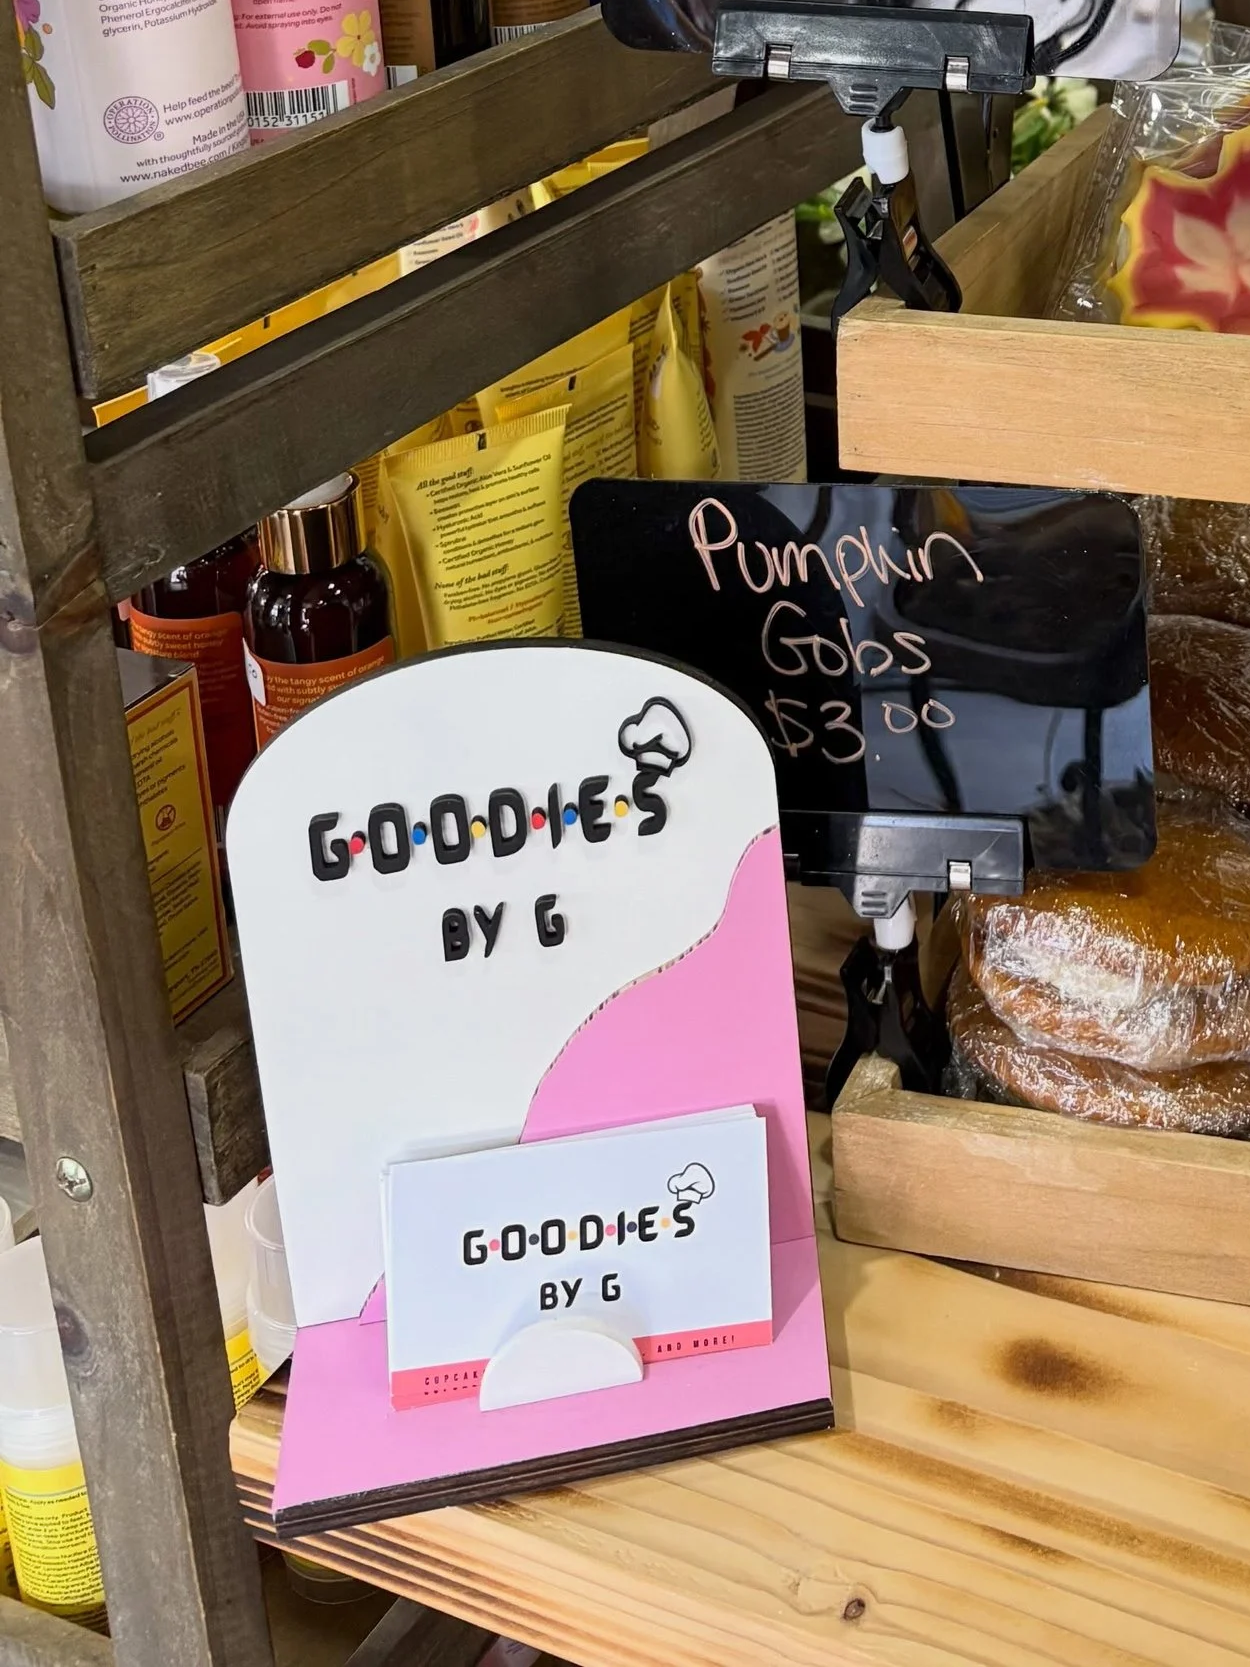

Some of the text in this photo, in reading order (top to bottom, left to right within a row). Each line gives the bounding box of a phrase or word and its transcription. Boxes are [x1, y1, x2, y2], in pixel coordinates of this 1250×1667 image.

[99, 1, 138, 14] Organic
[163, 88, 221, 113] Help feed the
[193, 128, 218, 145] Made
[120, 148, 227, 183] www.nakedbee.com
[136, 140, 212, 168] with thoughtfully
[688, 496, 985, 608] Pumpkin
[761, 600, 932, 678] Gobs
[290, 676, 317, 687] tangy
[318, 673, 346, 684] scent
[441, 893, 568, 963] BY G
[539, 1272, 623, 1312] BY G
